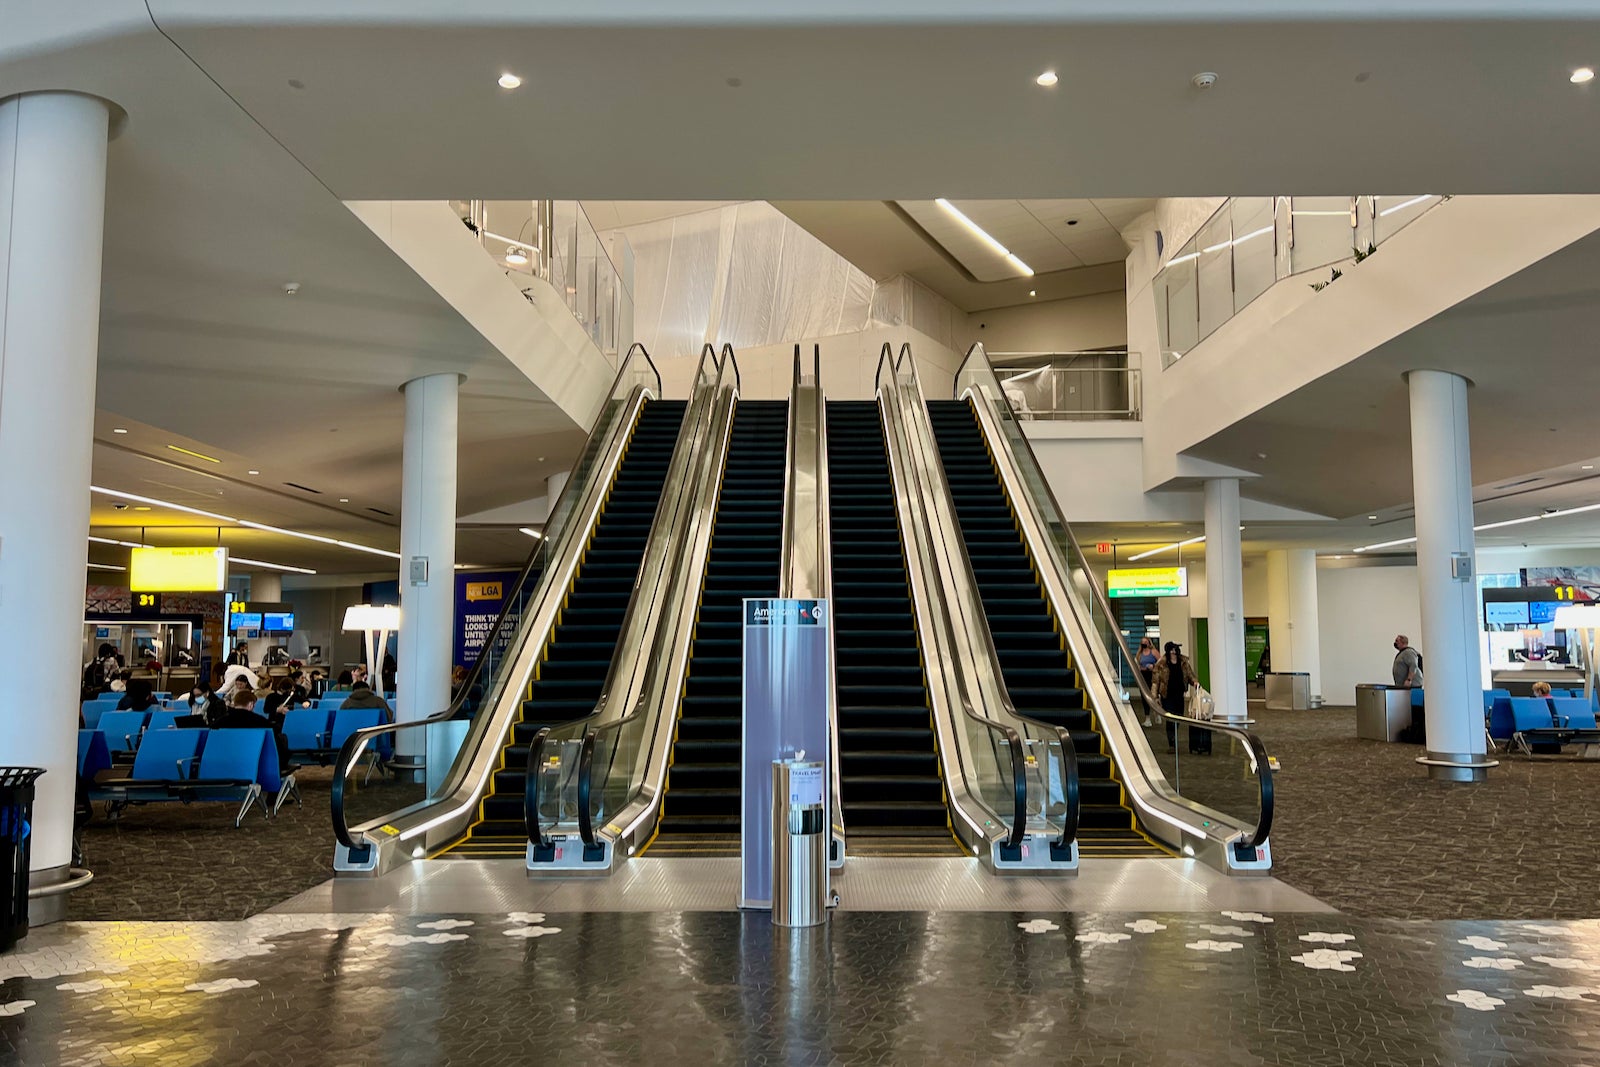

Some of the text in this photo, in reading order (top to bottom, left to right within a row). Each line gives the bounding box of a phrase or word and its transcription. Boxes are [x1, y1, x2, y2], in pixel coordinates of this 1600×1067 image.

[481, 586, 499, 596] LGA
[1555, 586, 1574, 600] 11
[139, 594, 154, 606] 31
[230, 601, 246, 613] 31
[465, 615, 487, 623] THINK
[465, 623, 489, 631] LOOKS
